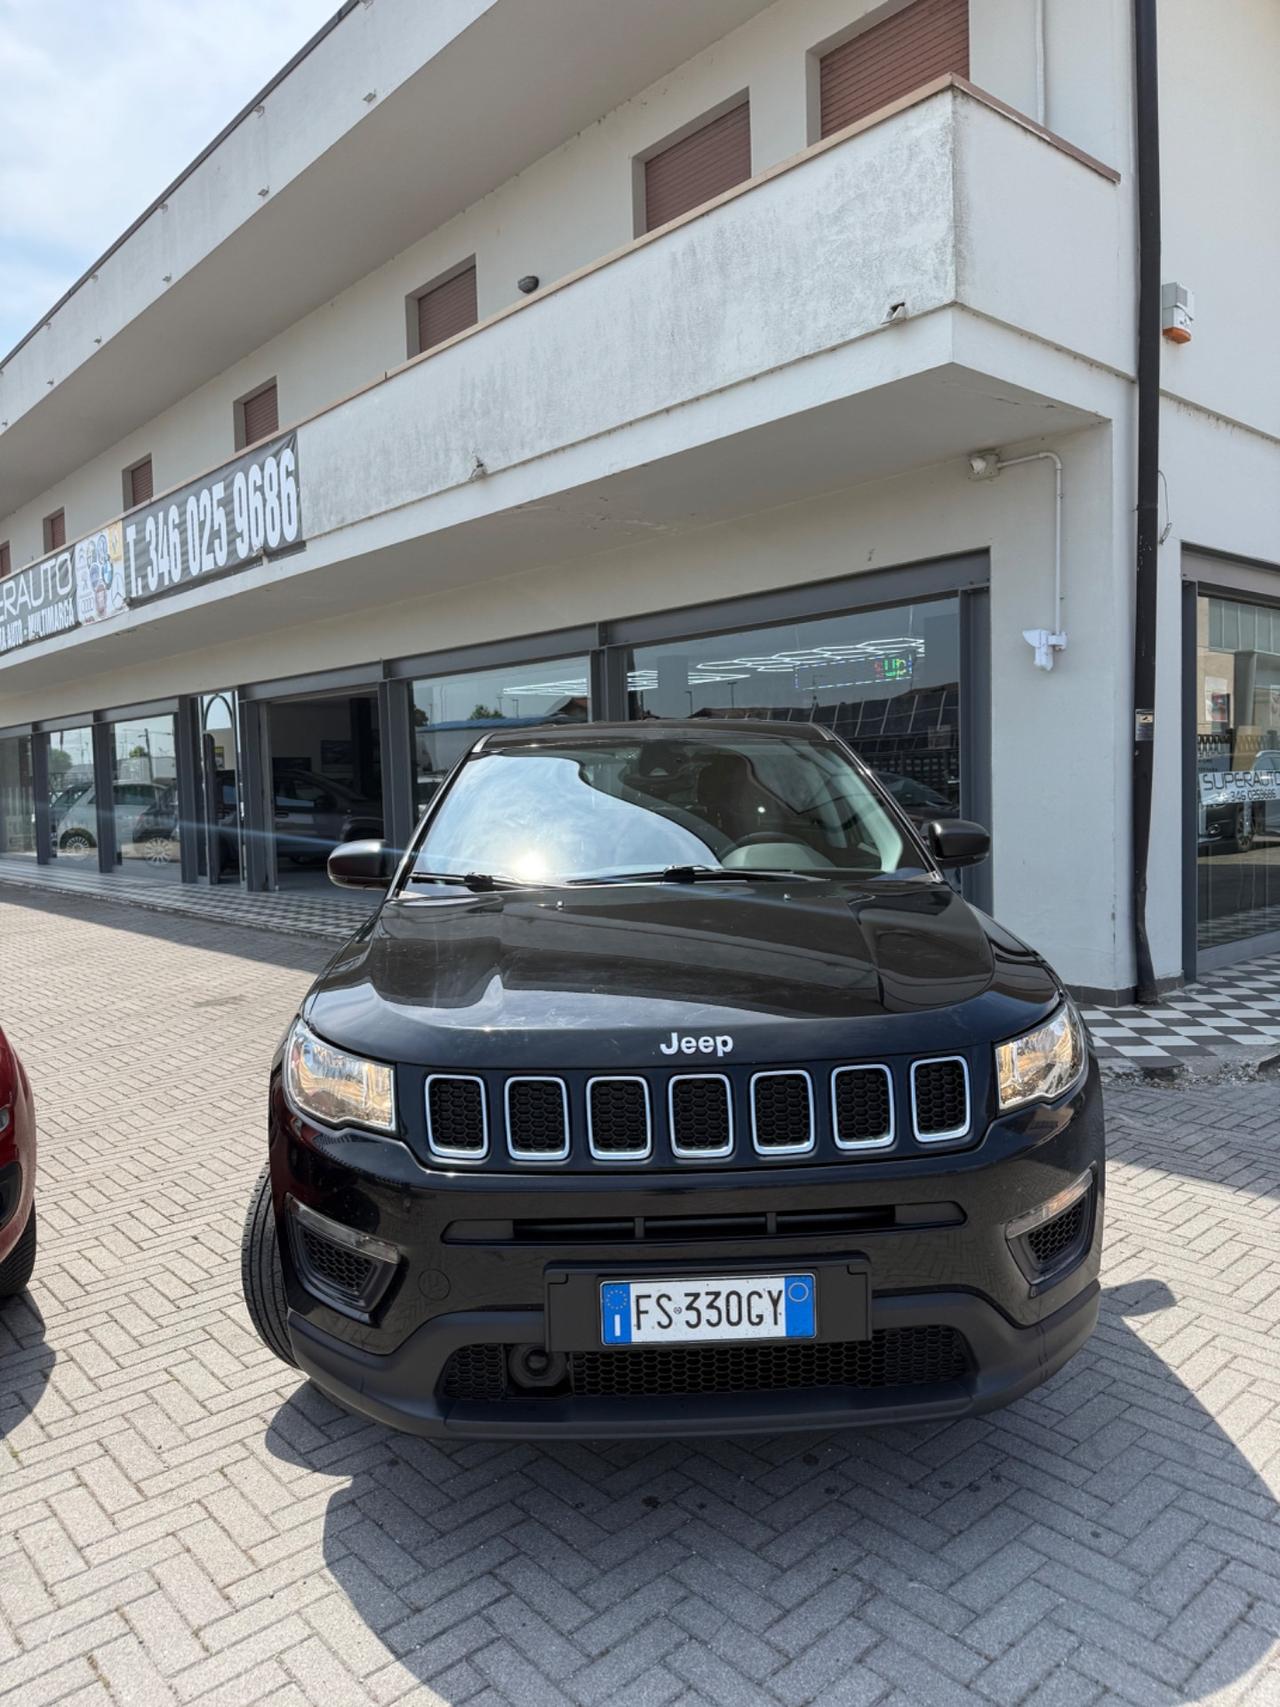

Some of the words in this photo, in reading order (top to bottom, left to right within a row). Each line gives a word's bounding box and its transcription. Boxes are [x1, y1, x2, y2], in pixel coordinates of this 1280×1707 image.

[146, 504, 182, 592] 346
[186, 481, 228, 576] 025
[233, 448, 298, 560] 9686
[660, 1032, 734, 1057] Jeep
